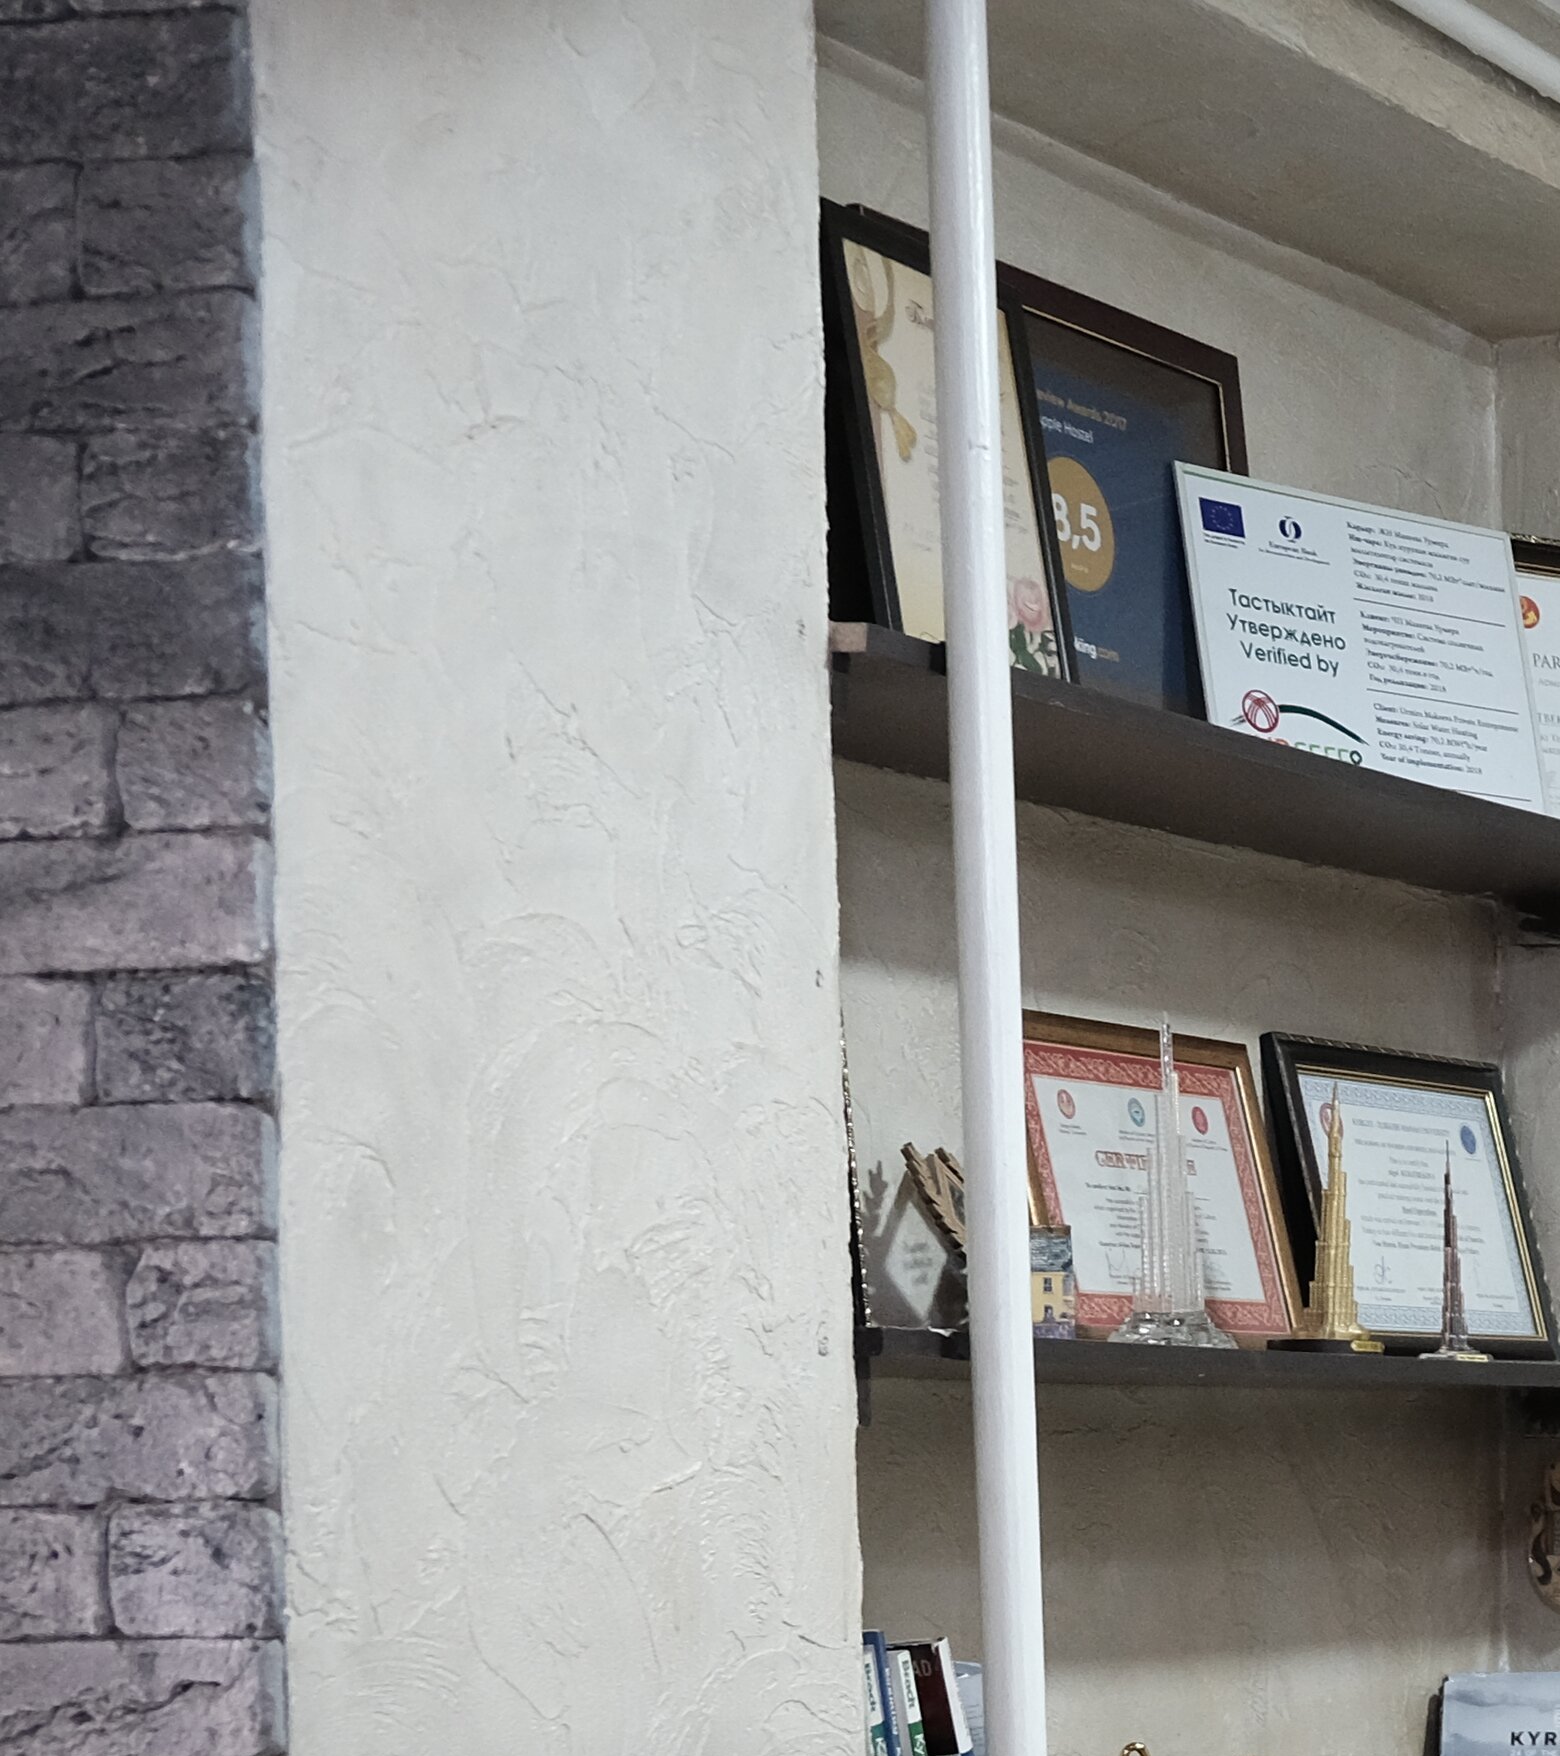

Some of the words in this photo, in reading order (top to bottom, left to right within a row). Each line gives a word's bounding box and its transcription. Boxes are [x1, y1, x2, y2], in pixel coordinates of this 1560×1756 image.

[1228, 588, 1336, 624] Тастыктайт
[1226, 613, 1346, 650] Утверждено
[1240, 640, 1311, 670] Verified
[1317, 654, 1339, 678] by
